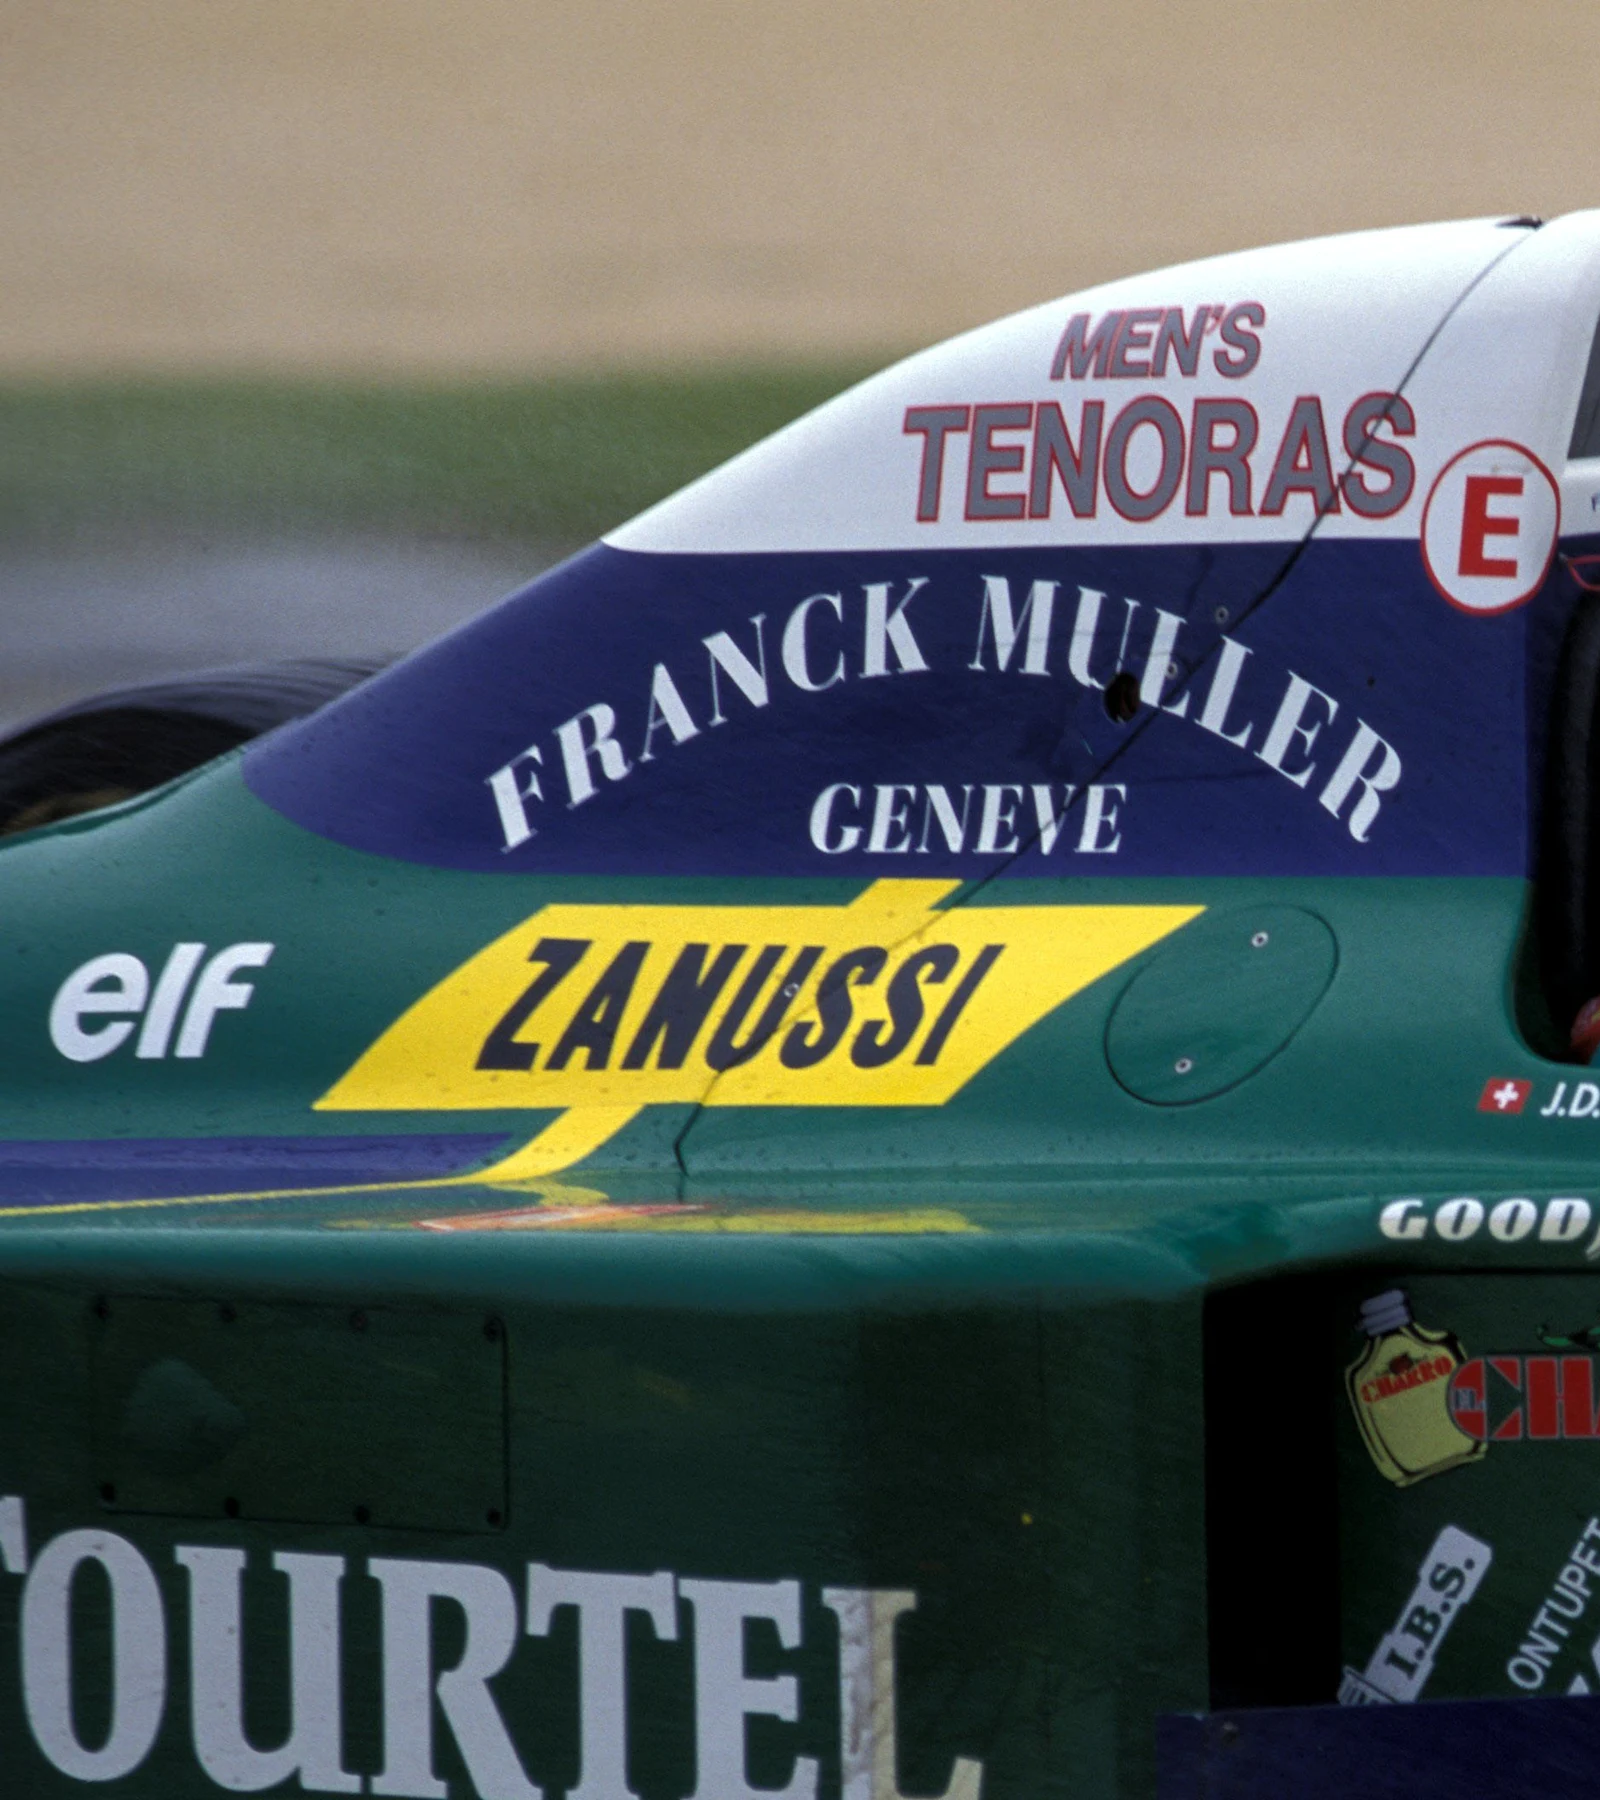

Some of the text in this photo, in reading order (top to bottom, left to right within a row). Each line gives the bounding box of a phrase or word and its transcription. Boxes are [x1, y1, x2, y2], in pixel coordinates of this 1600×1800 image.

[1050, 302, 1265, 382] MEN'S
[903, 392, 1416, 523] TENORAS
[1457, 476, 1525, 579] E
[484, 573, 1403, 854] FRANCK MULLER
[808, 782, 1128, 857] GENEVE
[48, 942, 275, 1064] elf
[474, 937, 1007, 1074] ZANUSSI
[1360, 1355, 1455, 1404] CHARRO
[1384, 1557, 1475, 1681] I.B.S.
